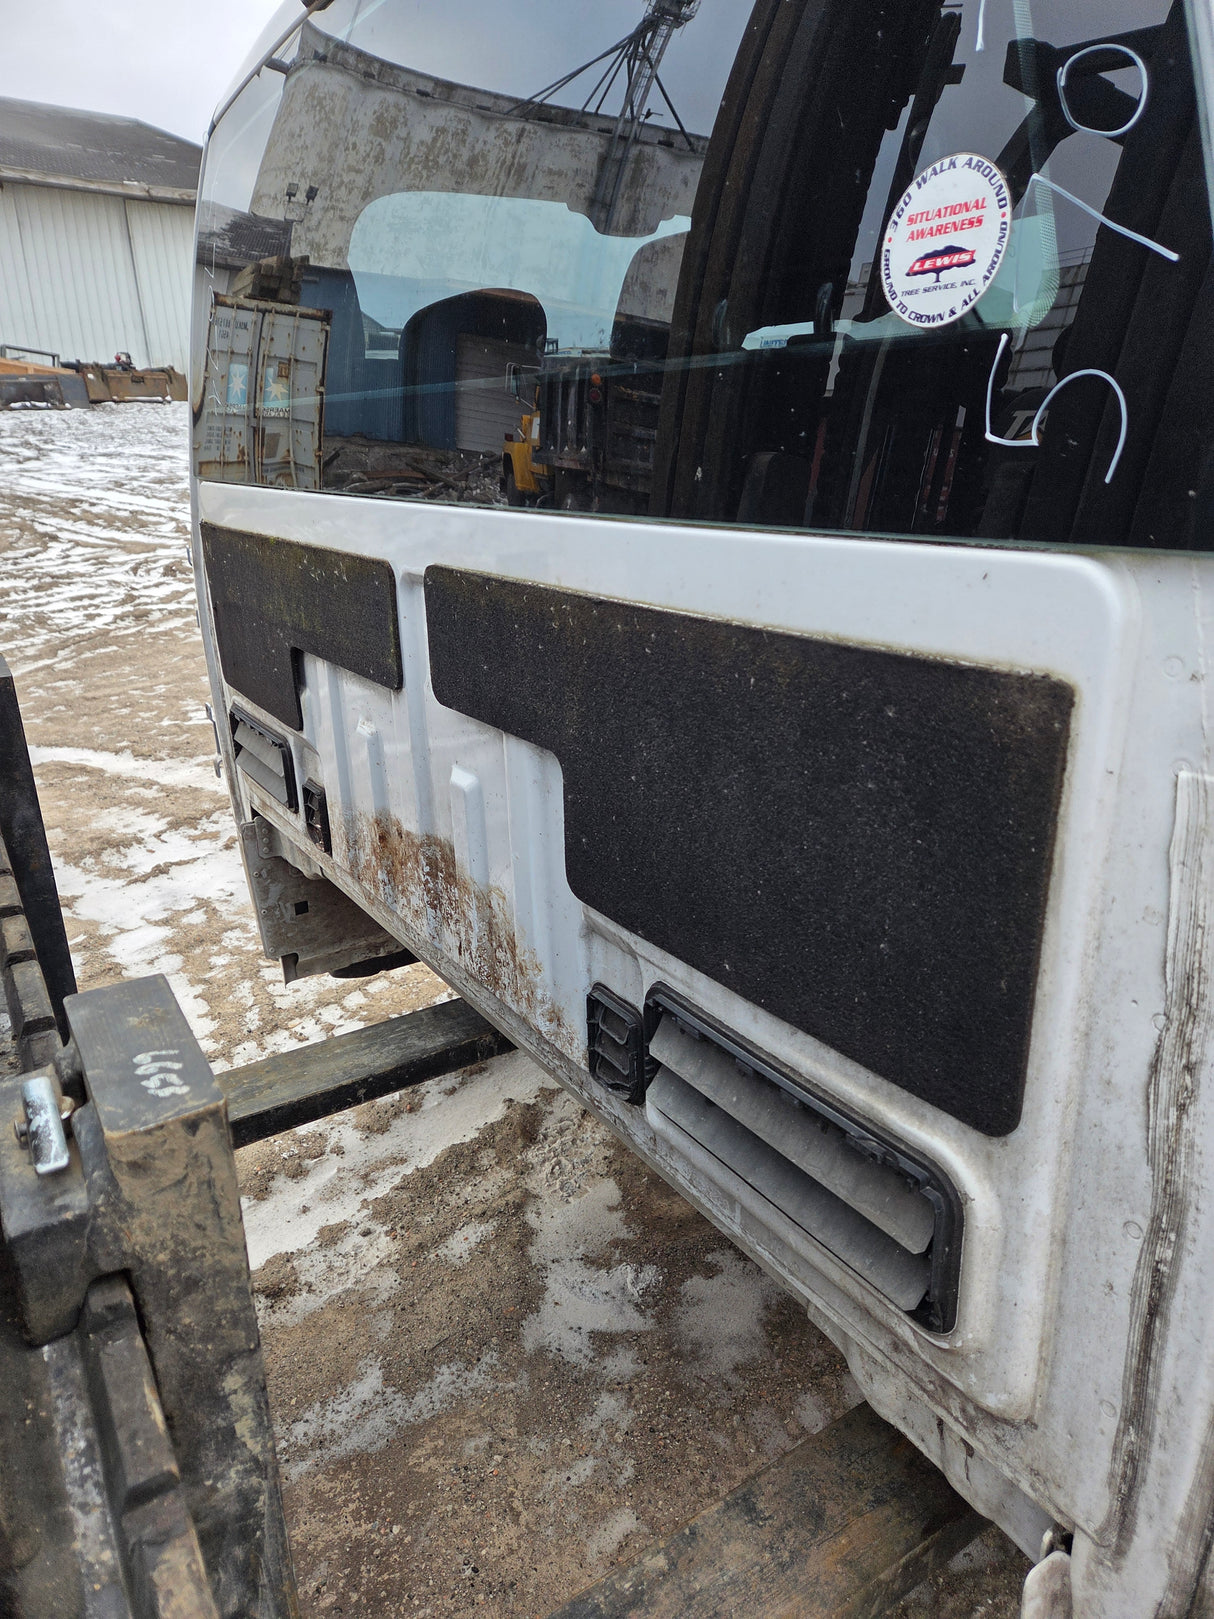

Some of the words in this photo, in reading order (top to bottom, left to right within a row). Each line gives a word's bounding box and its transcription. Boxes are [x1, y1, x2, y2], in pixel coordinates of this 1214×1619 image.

[888, 192, 913, 232] 360
[915, 156, 959, 190] WALK
[961, 156, 1008, 209] AROUND
[906, 197, 988, 226] SITUATIONAL
[906, 215, 985, 242] AWARENESS
[883, 249, 898, 301] GROUND
[895, 301, 909, 315] TO
[908, 310, 945, 324] CROWN
[948, 306, 957, 318] &
[961, 288, 980, 311] ALL
[982, 221, 1008, 286] AROUND
[912, 251, 974, 271] LEWIS
[901, 289, 920, 297] TREE
